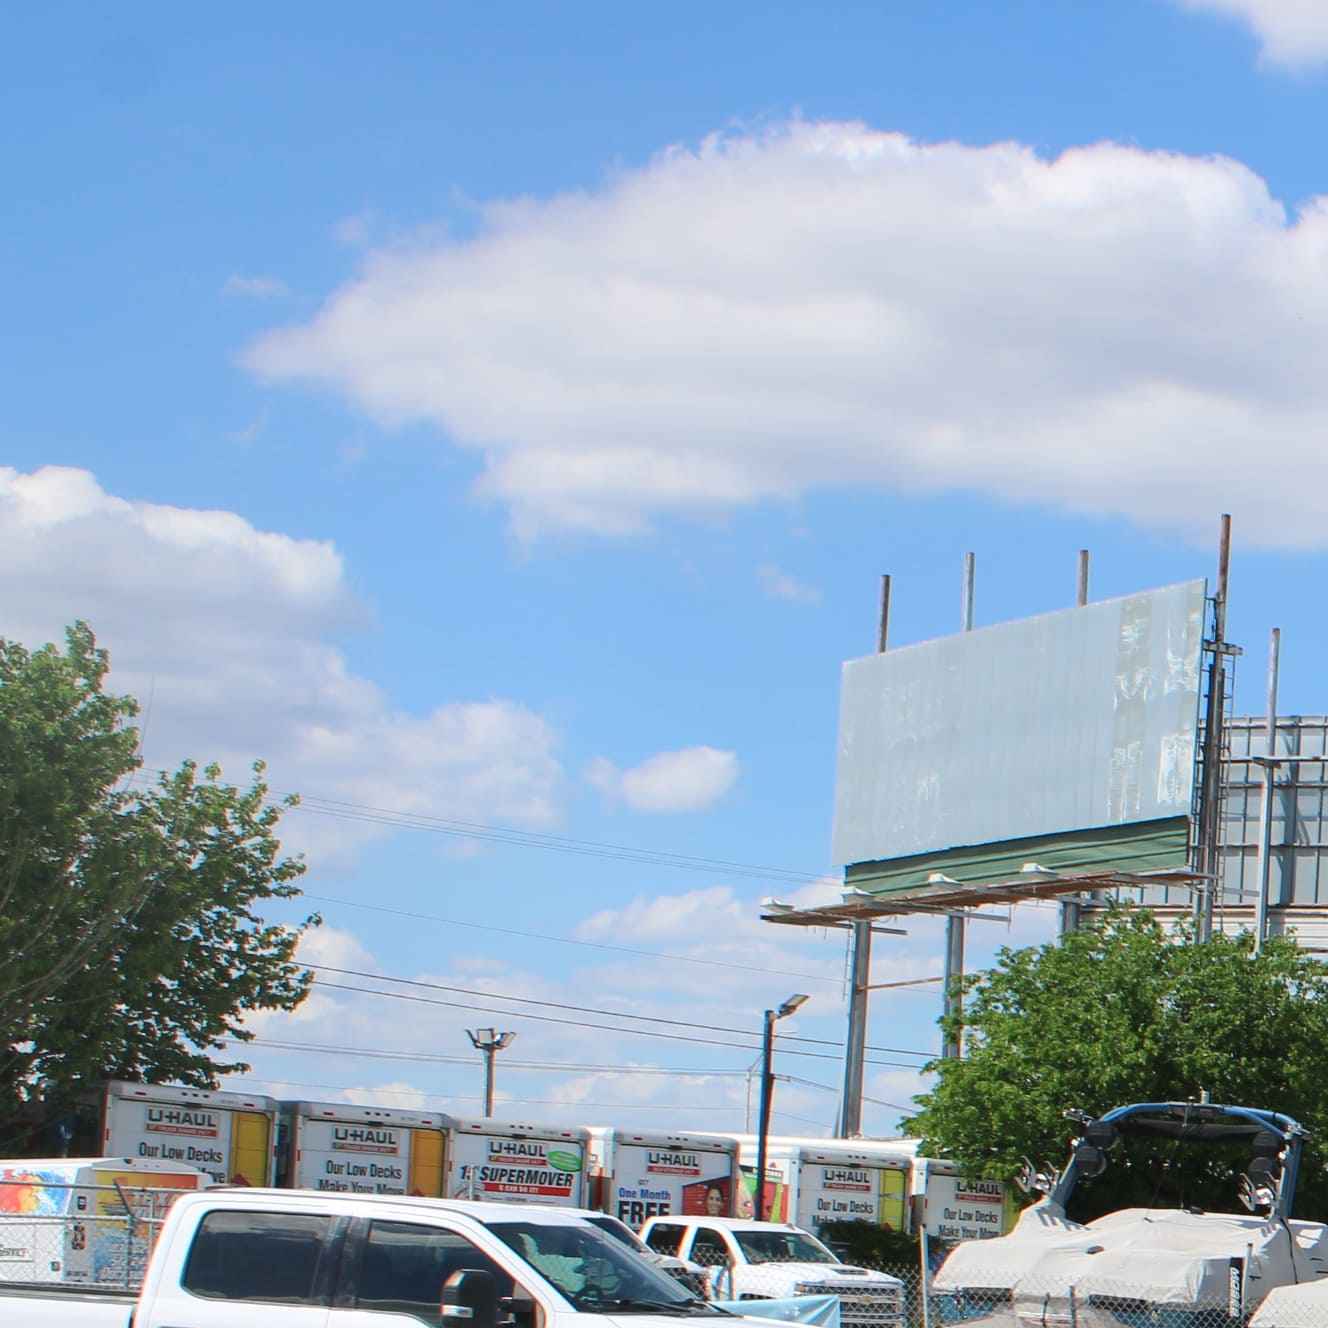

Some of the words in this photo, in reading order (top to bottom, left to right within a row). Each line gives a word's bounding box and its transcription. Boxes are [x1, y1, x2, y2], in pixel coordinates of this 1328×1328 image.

[148, 1109, 217, 1127] U-HAUL
[335, 1127, 397, 1145] U-HAUL
[139, 1141, 160, 1157] Our
[162, 1143, 184, 1161] Low
[187, 1146, 224, 1164] Decks
[490, 1141, 547, 1157] U-HAUL
[648, 1151, 699, 1167] U-HAUL
[326, 1160, 345, 1175] Our
[347, 1161, 368, 1177] Low
[370, 1163, 402, 1180] Decks
[480, 1166, 575, 1187] SUPERMOVER
[823, 1169, 870, 1184] U-HAUL
[618, 1187, 637, 1199] One
[640, 1188, 671, 1200] Month
[618, 1200, 671, 1224] FREE
